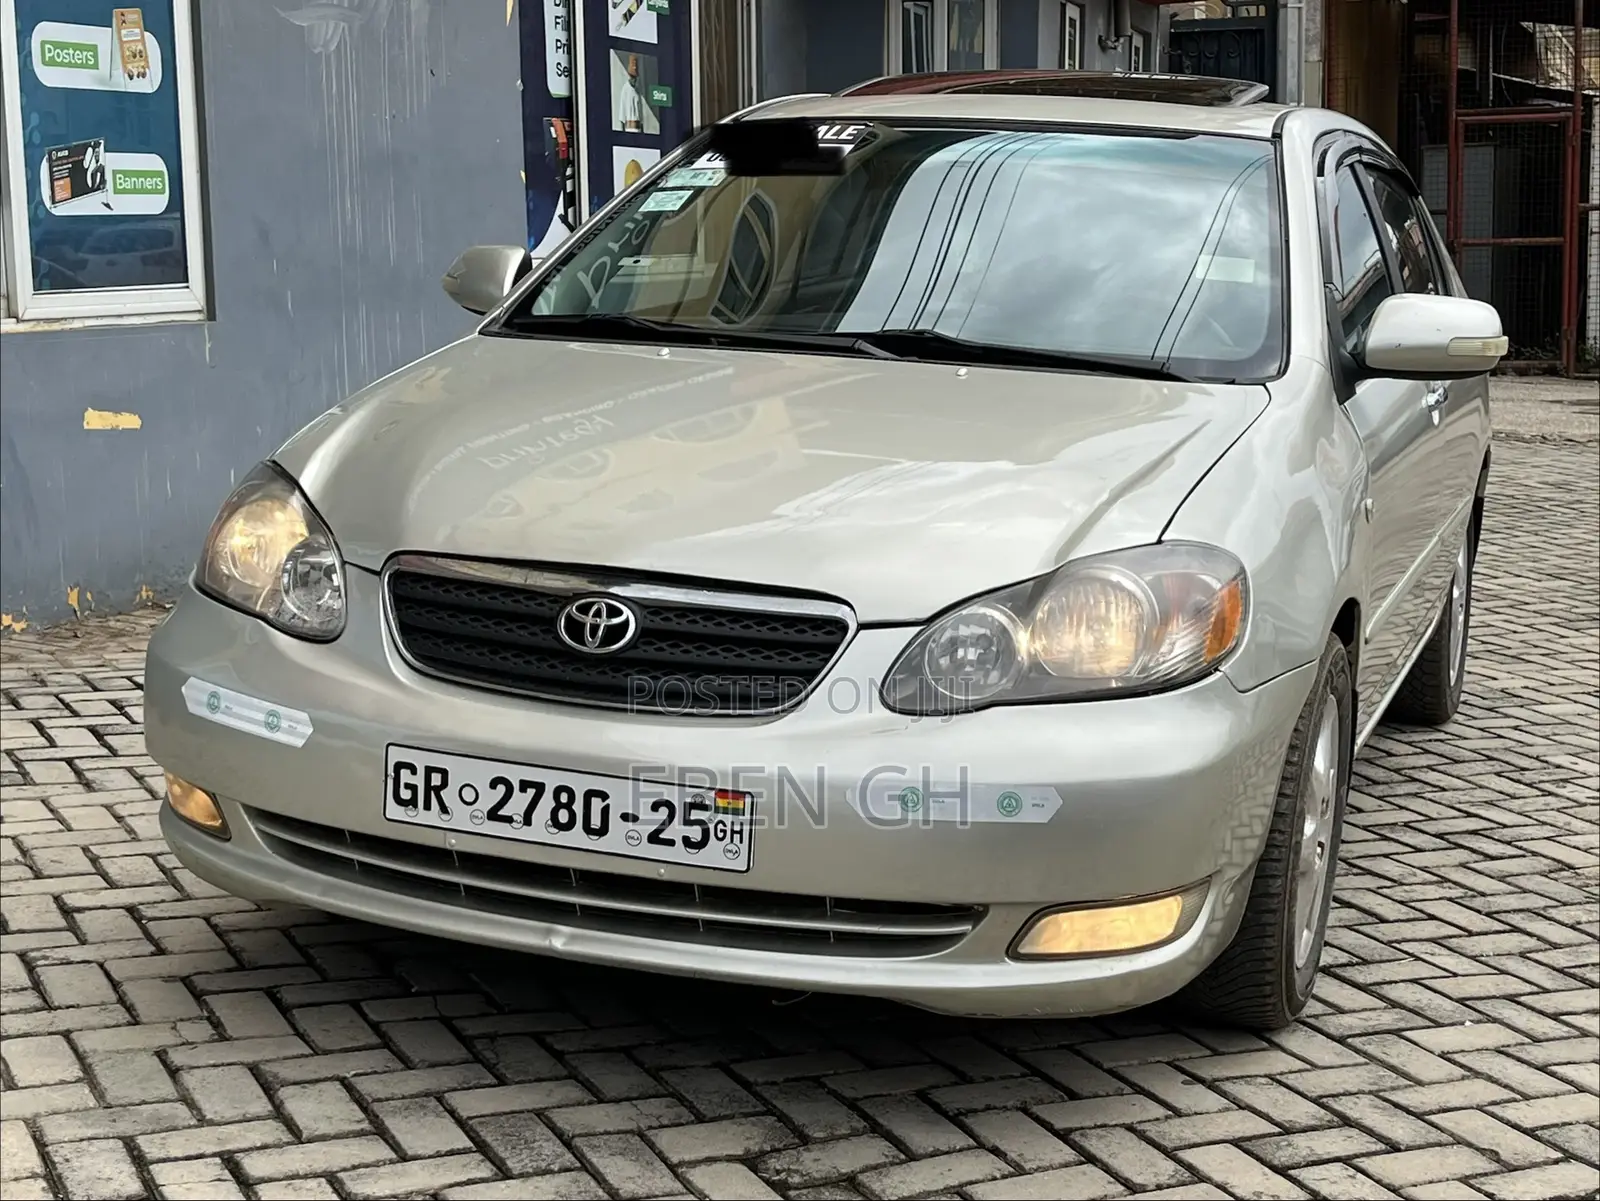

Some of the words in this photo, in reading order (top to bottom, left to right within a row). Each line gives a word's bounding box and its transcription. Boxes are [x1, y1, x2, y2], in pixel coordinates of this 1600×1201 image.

[45, 44, 95, 65] Posters
[817, 125, 866, 140] ALE
[116, 174, 163, 190] Banners
[392, 760, 450, 815] GR
[713, 818, 745, 844] GH
